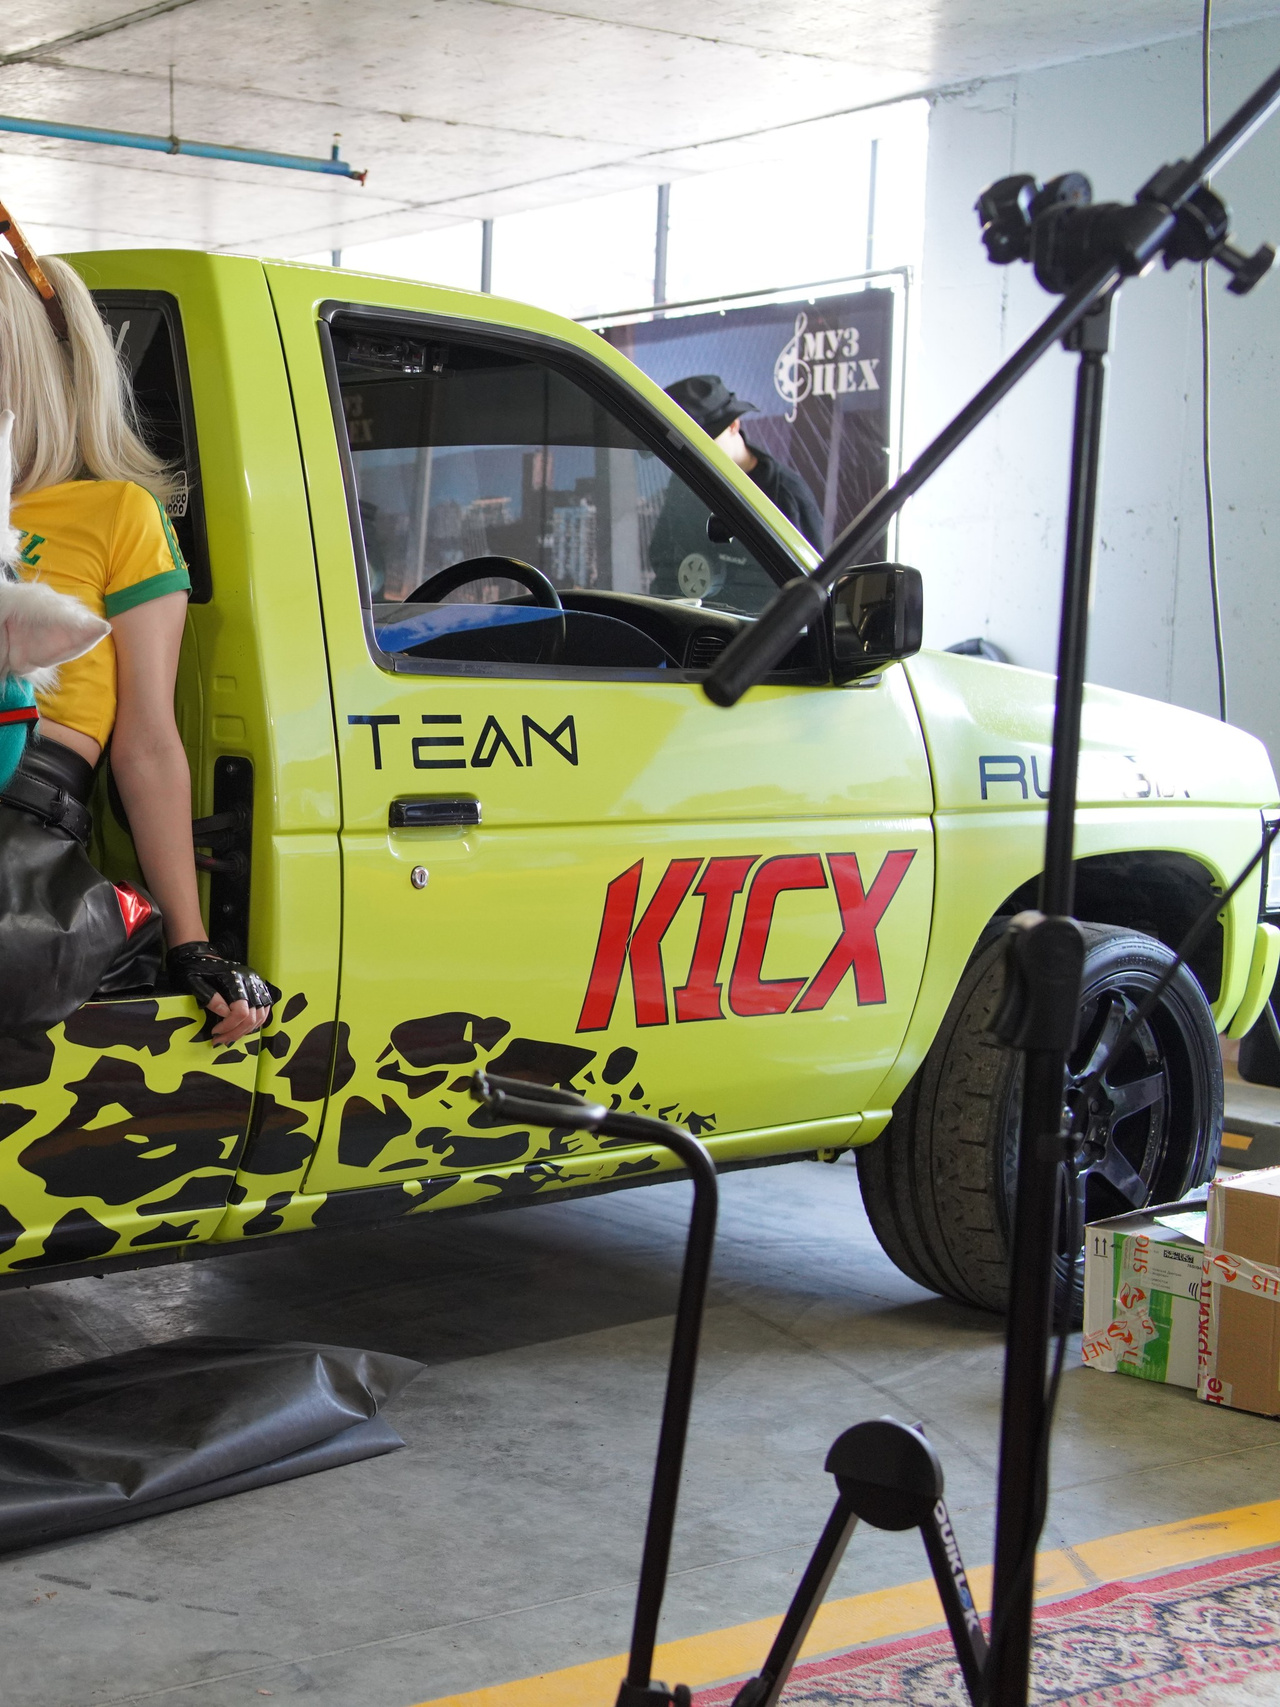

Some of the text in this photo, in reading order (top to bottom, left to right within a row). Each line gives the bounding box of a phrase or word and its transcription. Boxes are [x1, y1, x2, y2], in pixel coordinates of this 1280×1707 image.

[802, 327, 860, 361] МУЗ
[812, 358, 880, 400] ЦЕХ
[347, 713, 580, 771] TEAM
[576, 848, 918, 1034] KICX
